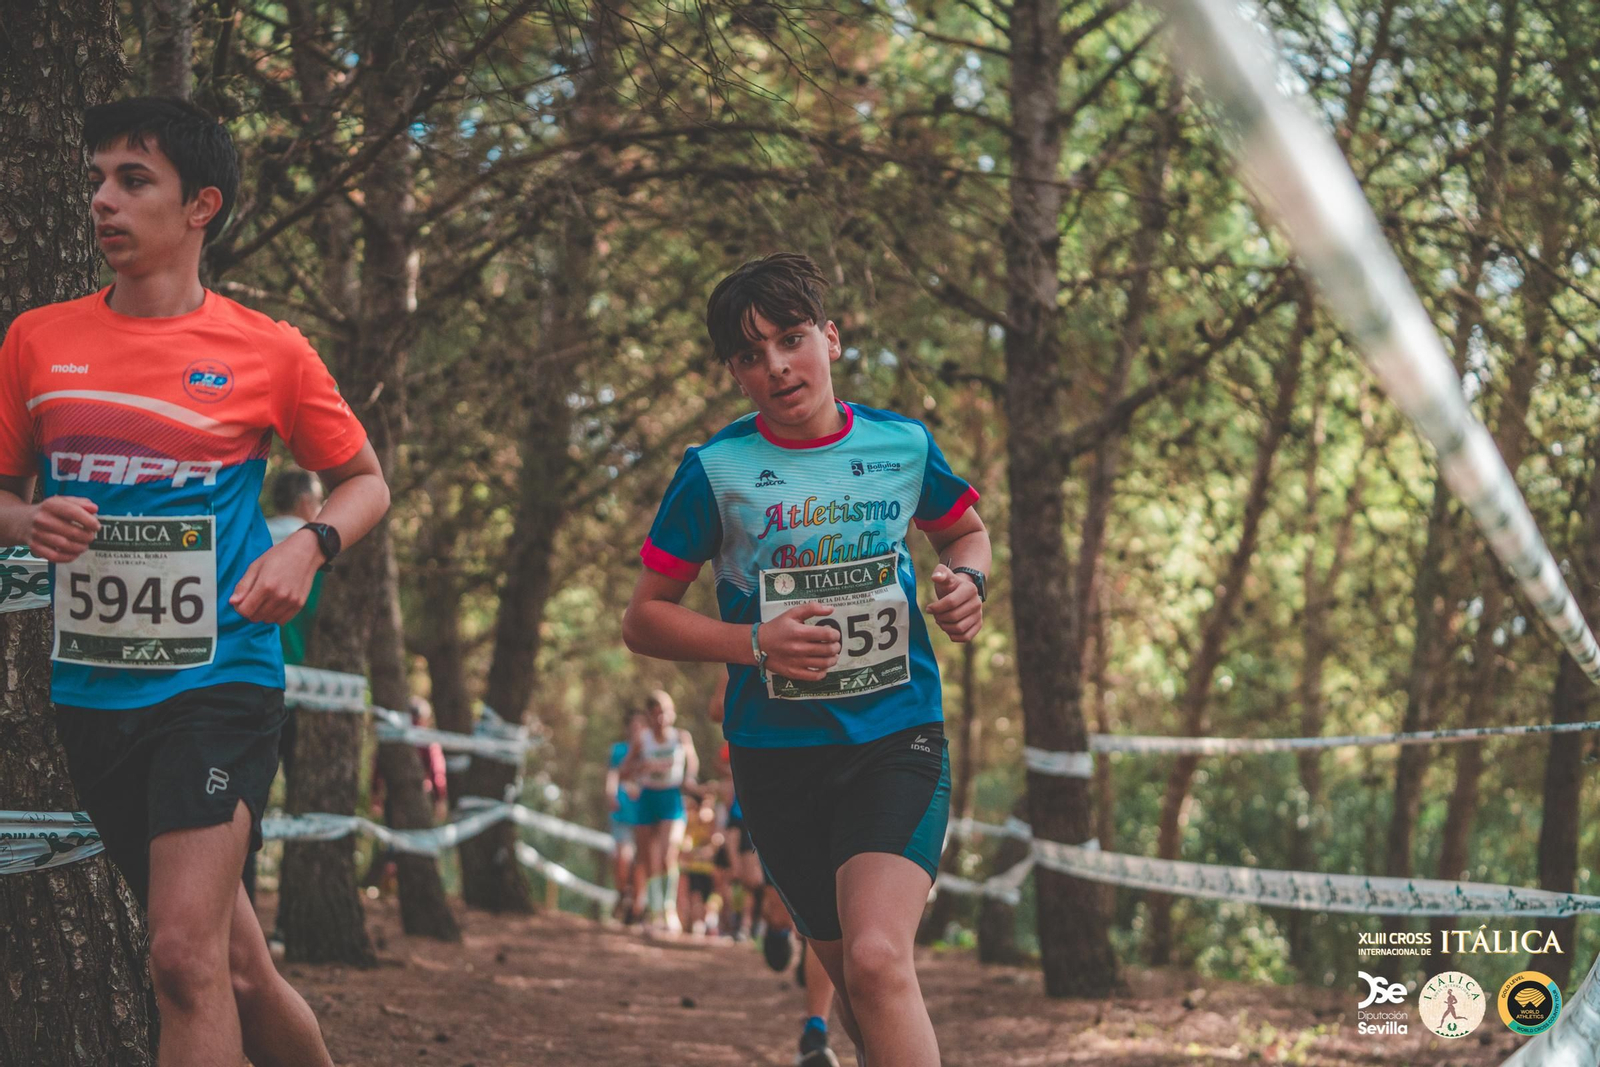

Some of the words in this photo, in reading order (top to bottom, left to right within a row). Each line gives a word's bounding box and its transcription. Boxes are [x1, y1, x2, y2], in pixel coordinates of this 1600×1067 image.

[51, 363, 89, 374] mobel
[51, 452, 223, 488] CAPA
[757, 495, 901, 540] Atletismo
[805, 567, 873, 589] ITÁLICA
[70, 572, 204, 624] 5946
